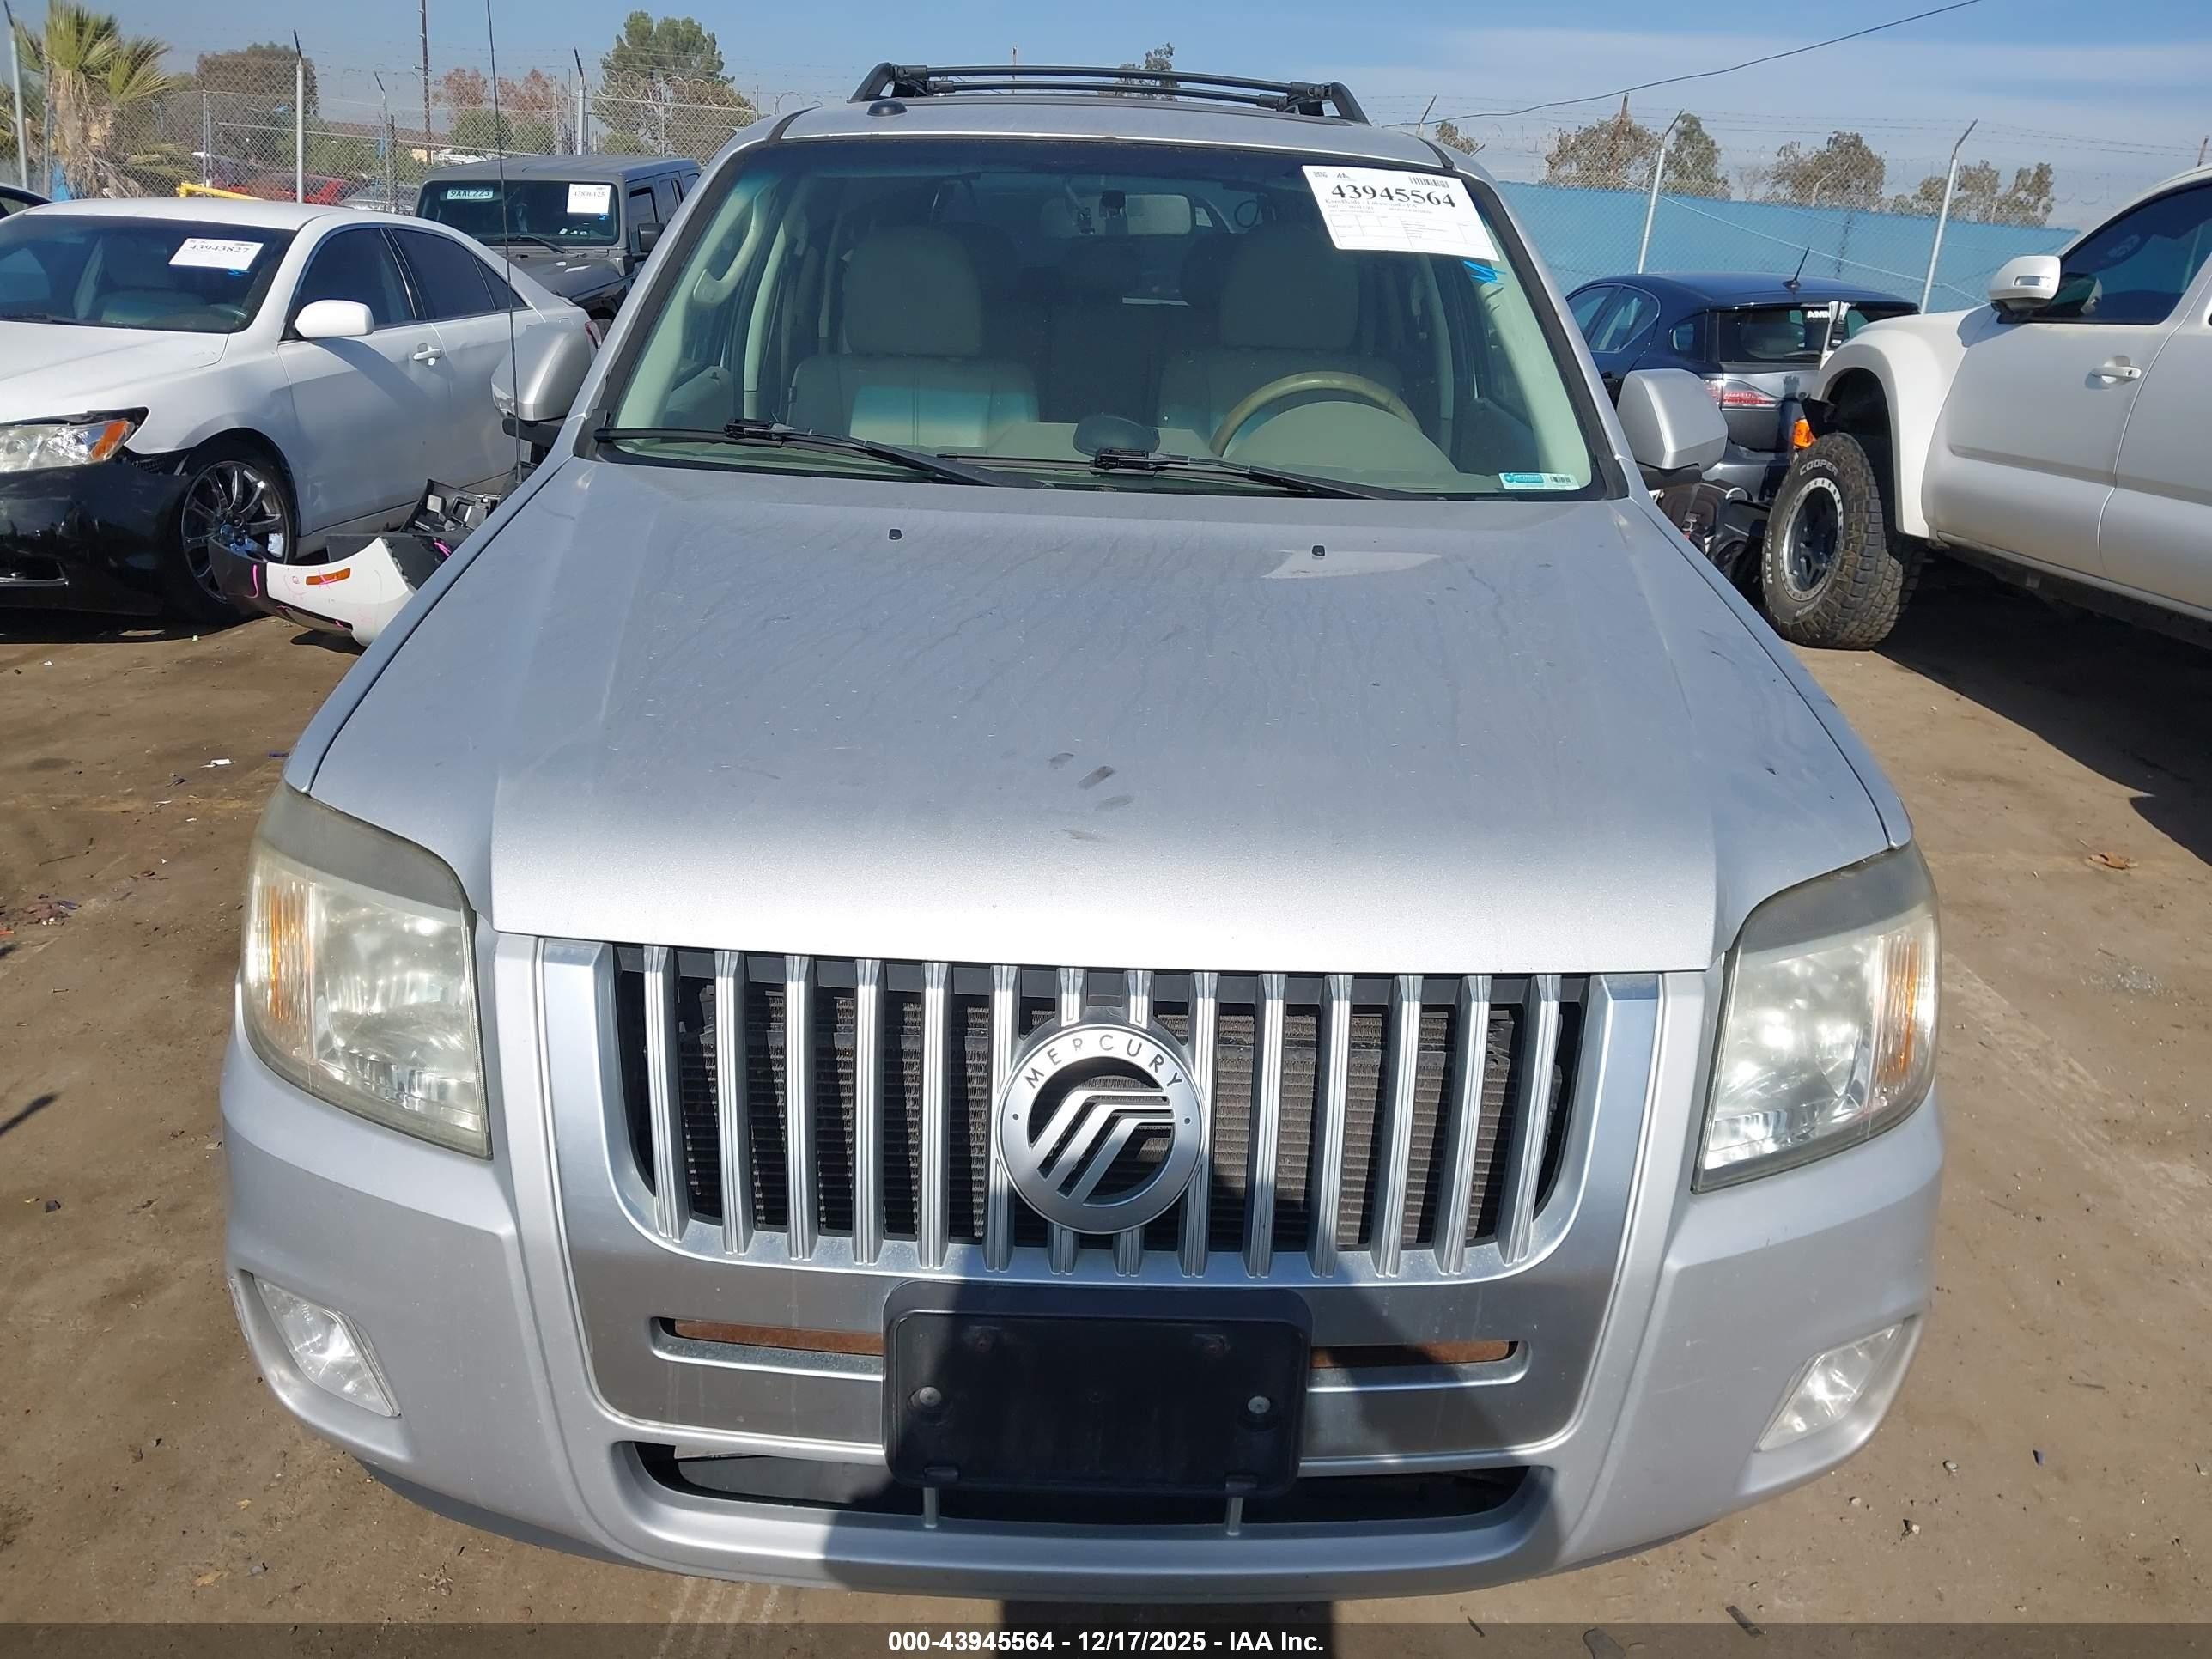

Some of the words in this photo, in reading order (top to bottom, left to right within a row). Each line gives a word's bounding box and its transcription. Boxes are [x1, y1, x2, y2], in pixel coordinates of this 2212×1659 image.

[1331, 184, 1456, 208] 43945564
[1800, 459, 1838, 476] COOPER
[1024, 1034, 1183, 1090] MERCURY
